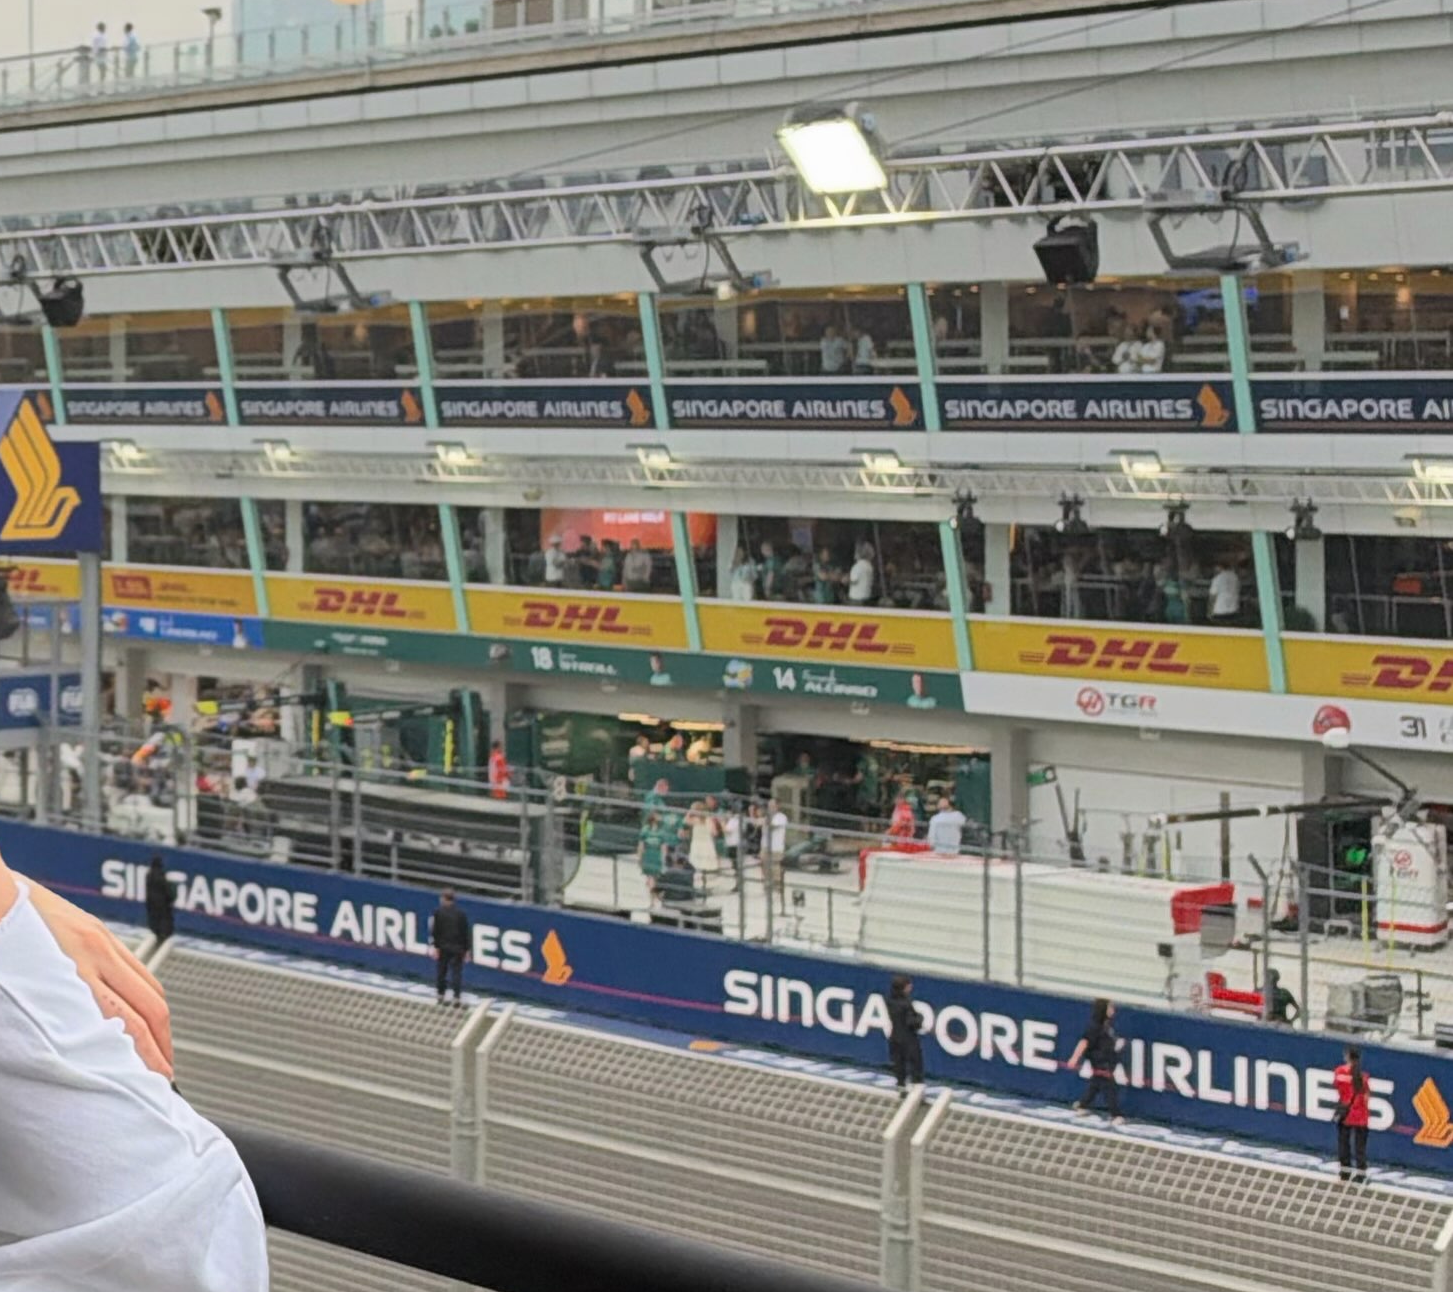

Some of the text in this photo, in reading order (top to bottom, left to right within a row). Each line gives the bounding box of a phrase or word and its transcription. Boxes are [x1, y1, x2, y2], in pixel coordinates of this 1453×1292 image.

[441, 400, 623, 418] SINGAPORE AIRLINES
[672, 399, 886, 420] SINGAPORE AIRLINES
[945, 398, 1193, 420] SINGAPORE AIRLINES
[1260, 398, 1453, 421] SINGAPORE AI
[314, 587, 406, 618] DHL
[522, 601, 629, 634] DHL
[764, 617, 889, 653] DHL
[531, 646, 554, 671] 18
[1046, 635, 1190, 674] DHL
[773, 666, 797, 692] 14
[1106, 692, 1158, 709] TGR
[1399, 715, 1427, 740] 31
[101, 860, 533, 974] SIGAPORE AIRLES
